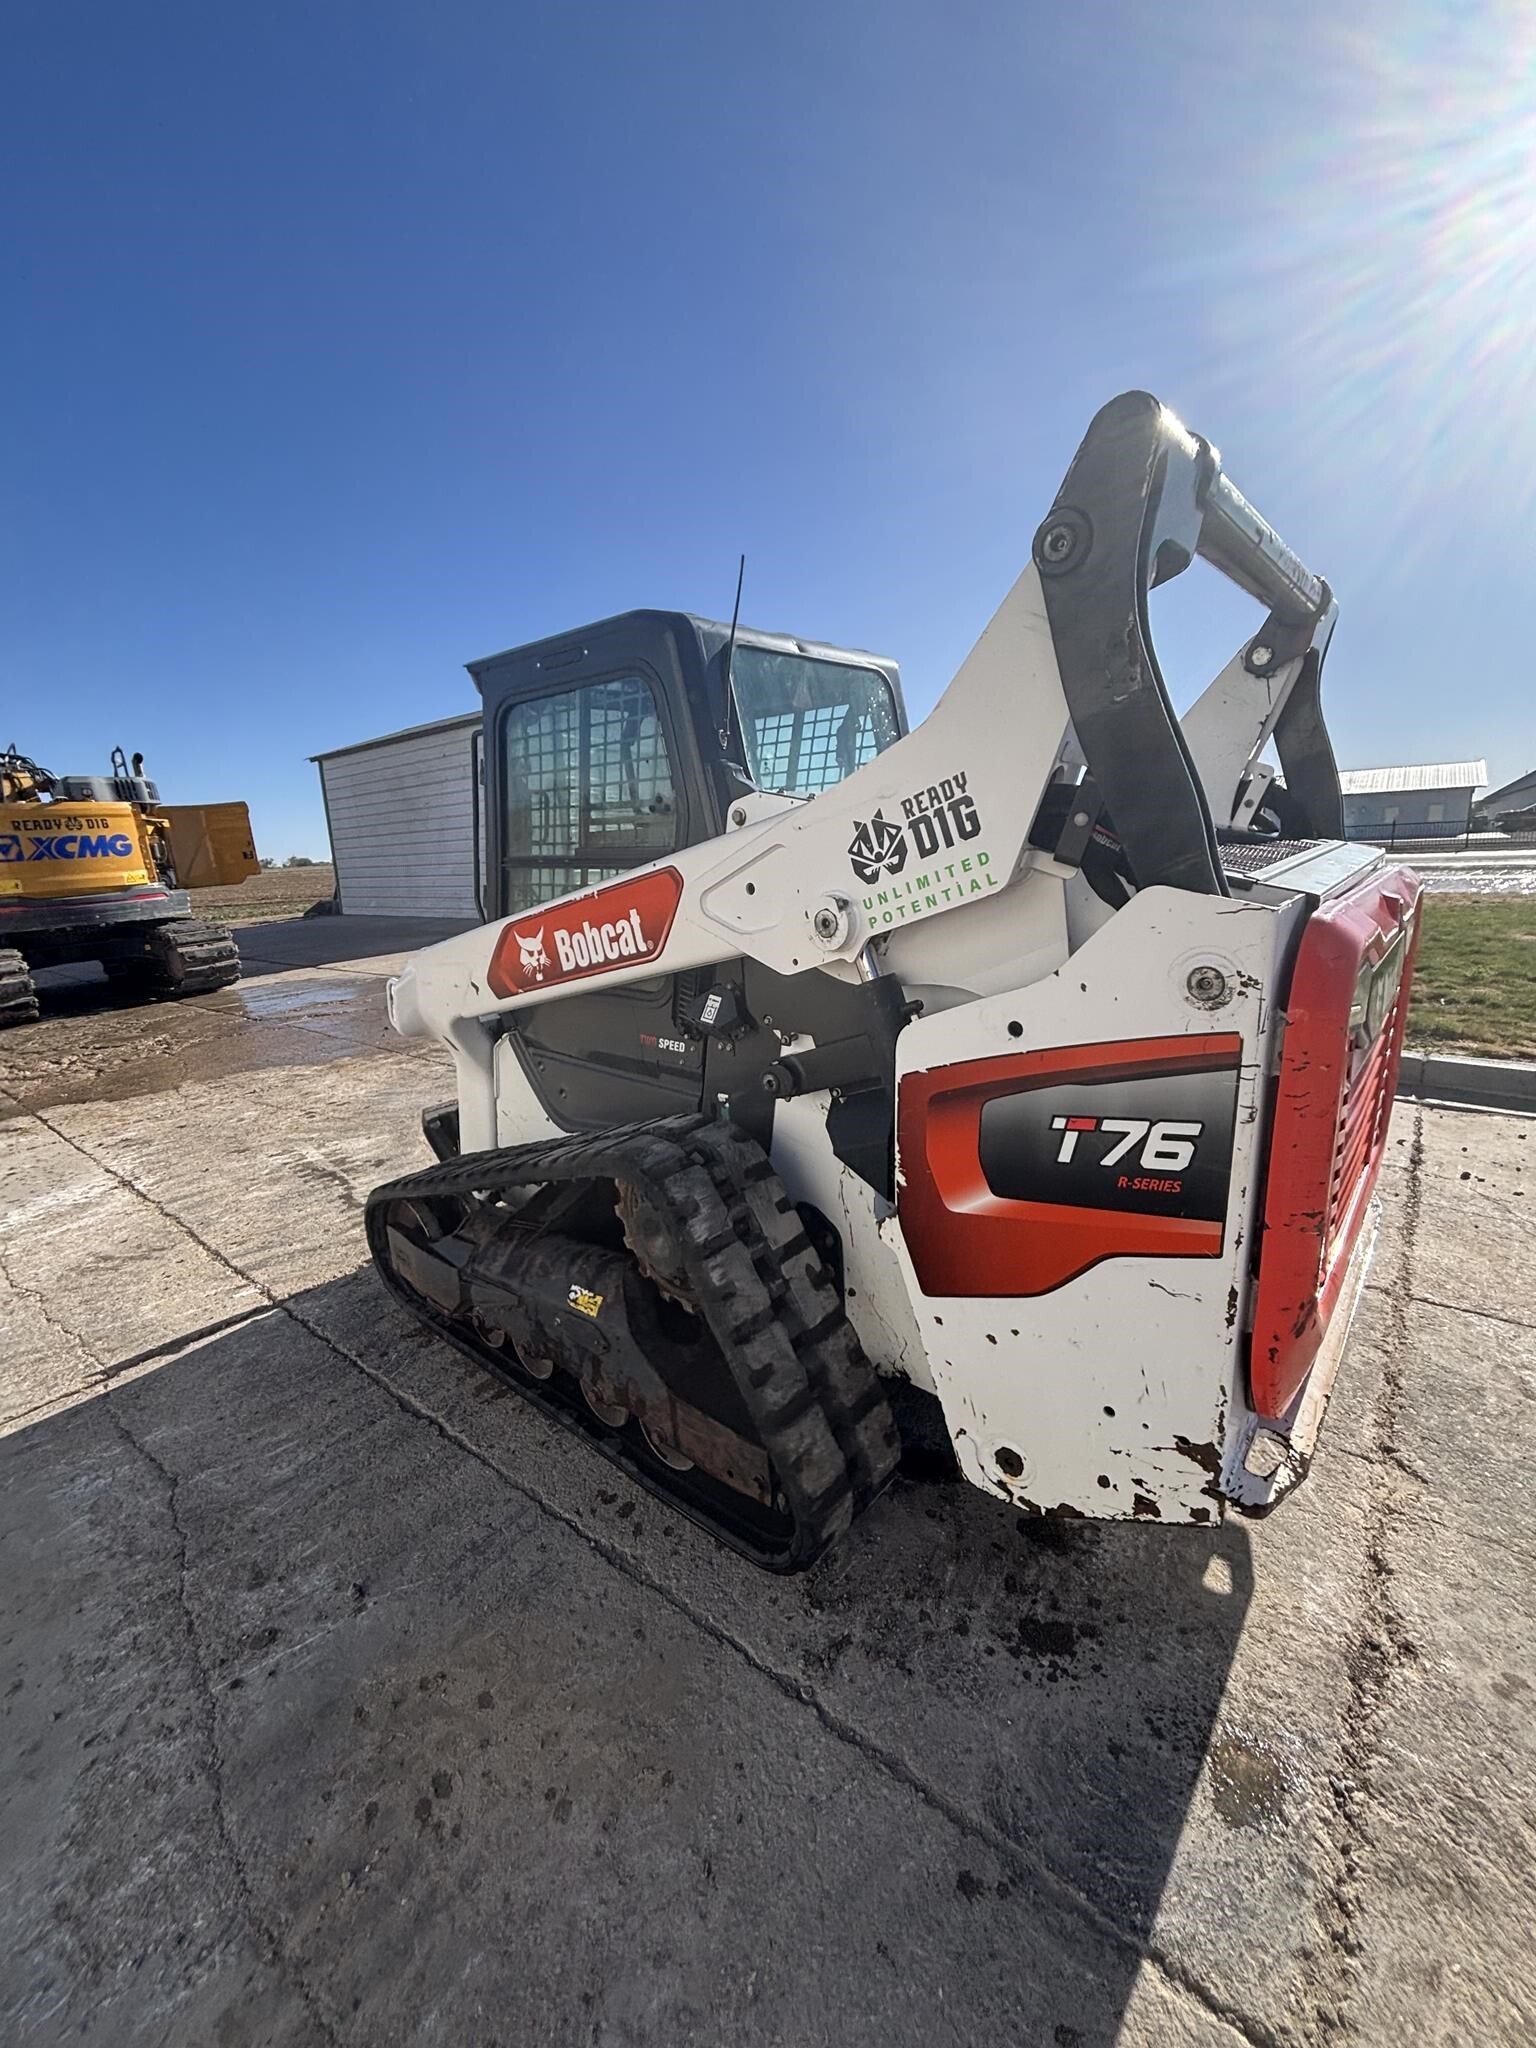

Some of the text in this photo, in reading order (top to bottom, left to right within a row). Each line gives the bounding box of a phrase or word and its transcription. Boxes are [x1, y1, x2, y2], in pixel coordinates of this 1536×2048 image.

[900, 770, 968, 820] READY
[11, 818, 110, 831] READY DIG
[27, 834, 133, 861] XCMG
[908, 794, 982, 860] DIG
[862, 850, 991, 911] UNLIMITED
[868, 872, 999, 930] POTENTIAL
[553, 908, 649, 972] Bobcat
[658, 1037, 686, 1053] SPEED
[1051, 1116, 1203, 1172] T76
[1117, 1176, 1183, 1194] R-SERIES
